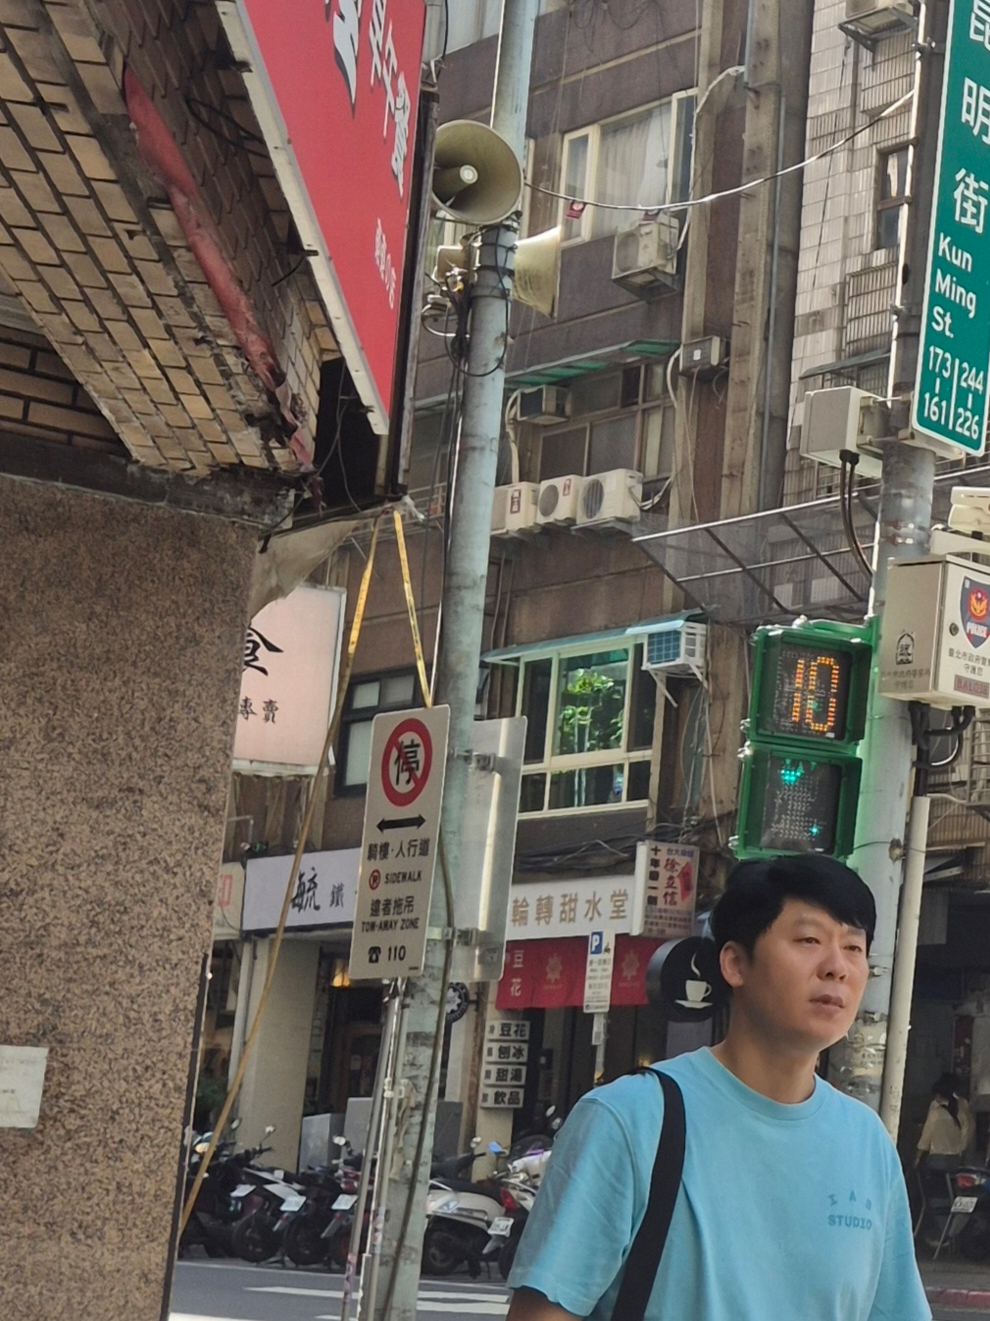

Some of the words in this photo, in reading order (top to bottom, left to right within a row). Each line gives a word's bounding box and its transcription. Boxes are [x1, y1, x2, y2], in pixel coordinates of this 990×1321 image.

[938, 232, 972, 272] Kun
[935, 269, 977, 319] Ming
[931, 306, 954, 338] St.
[929, 345, 951, 378] 173
[960, 362, 984, 395] 244
[924, 392, 947, 425] 161
[955, 408, 979, 440] 226
[792, 656, 840, 732] 10
[394, 739, 421, 786] 停
[384, 869, 422, 884] SIDEWALK
[400, 918, 420, 931] ZONE
[511, 889, 629, 927] 輪轉甜水堂
[388, 945, 406, 962] 110
[510, 950, 524, 997] 豆花
[499, 1023, 527, 1037] 豆花
[494, 1091, 520, 1105] 飲品
[828, 1214, 872, 1230] STUDIO
